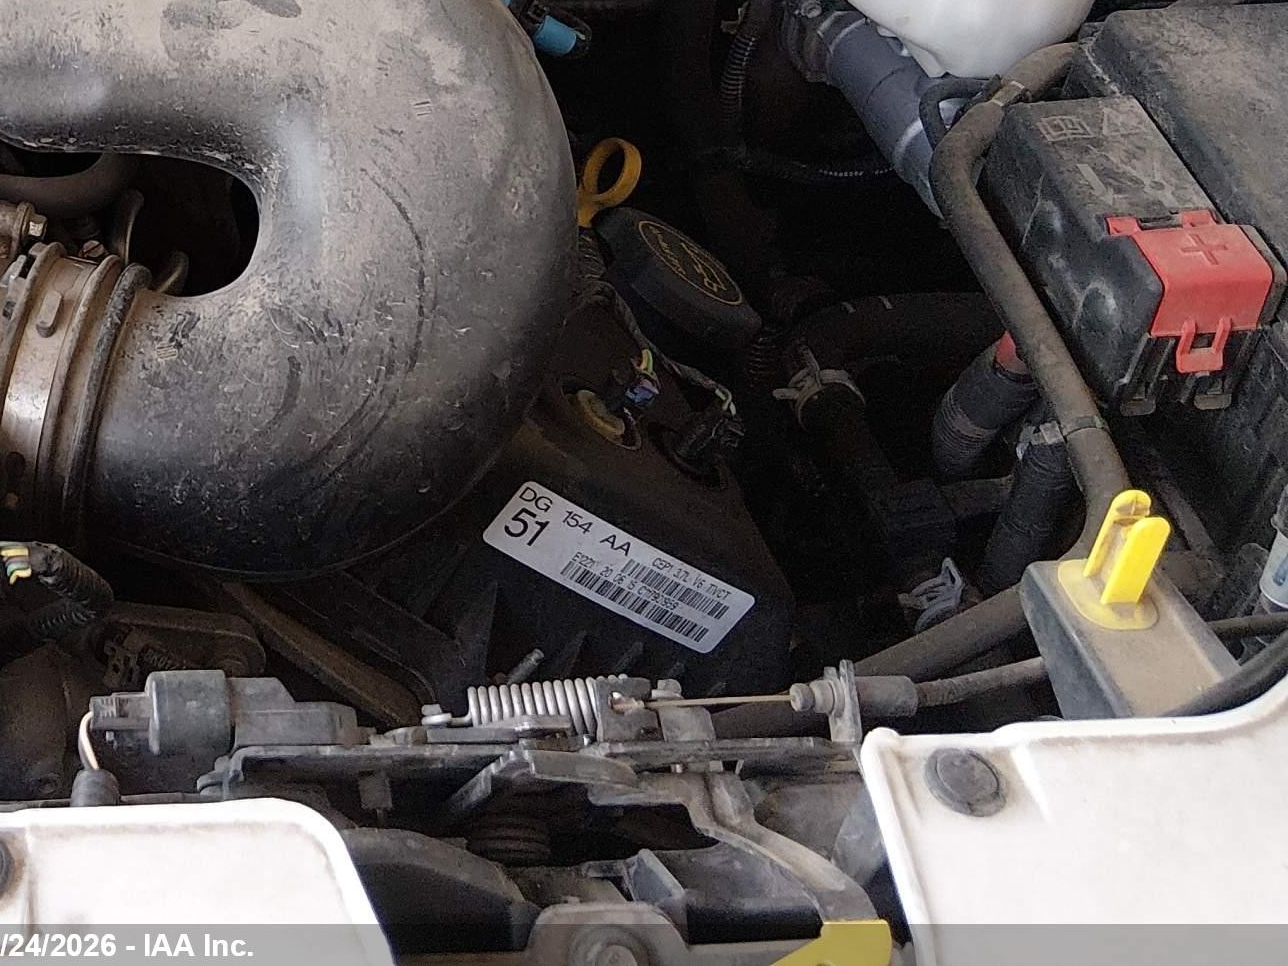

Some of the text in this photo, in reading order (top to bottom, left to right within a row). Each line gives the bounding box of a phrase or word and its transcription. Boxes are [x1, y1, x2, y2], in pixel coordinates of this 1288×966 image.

[504, 508, 550, 547] 51
[519, 487, 632, 556] DG 154 AA
[694, 574, 706, 589] V6
